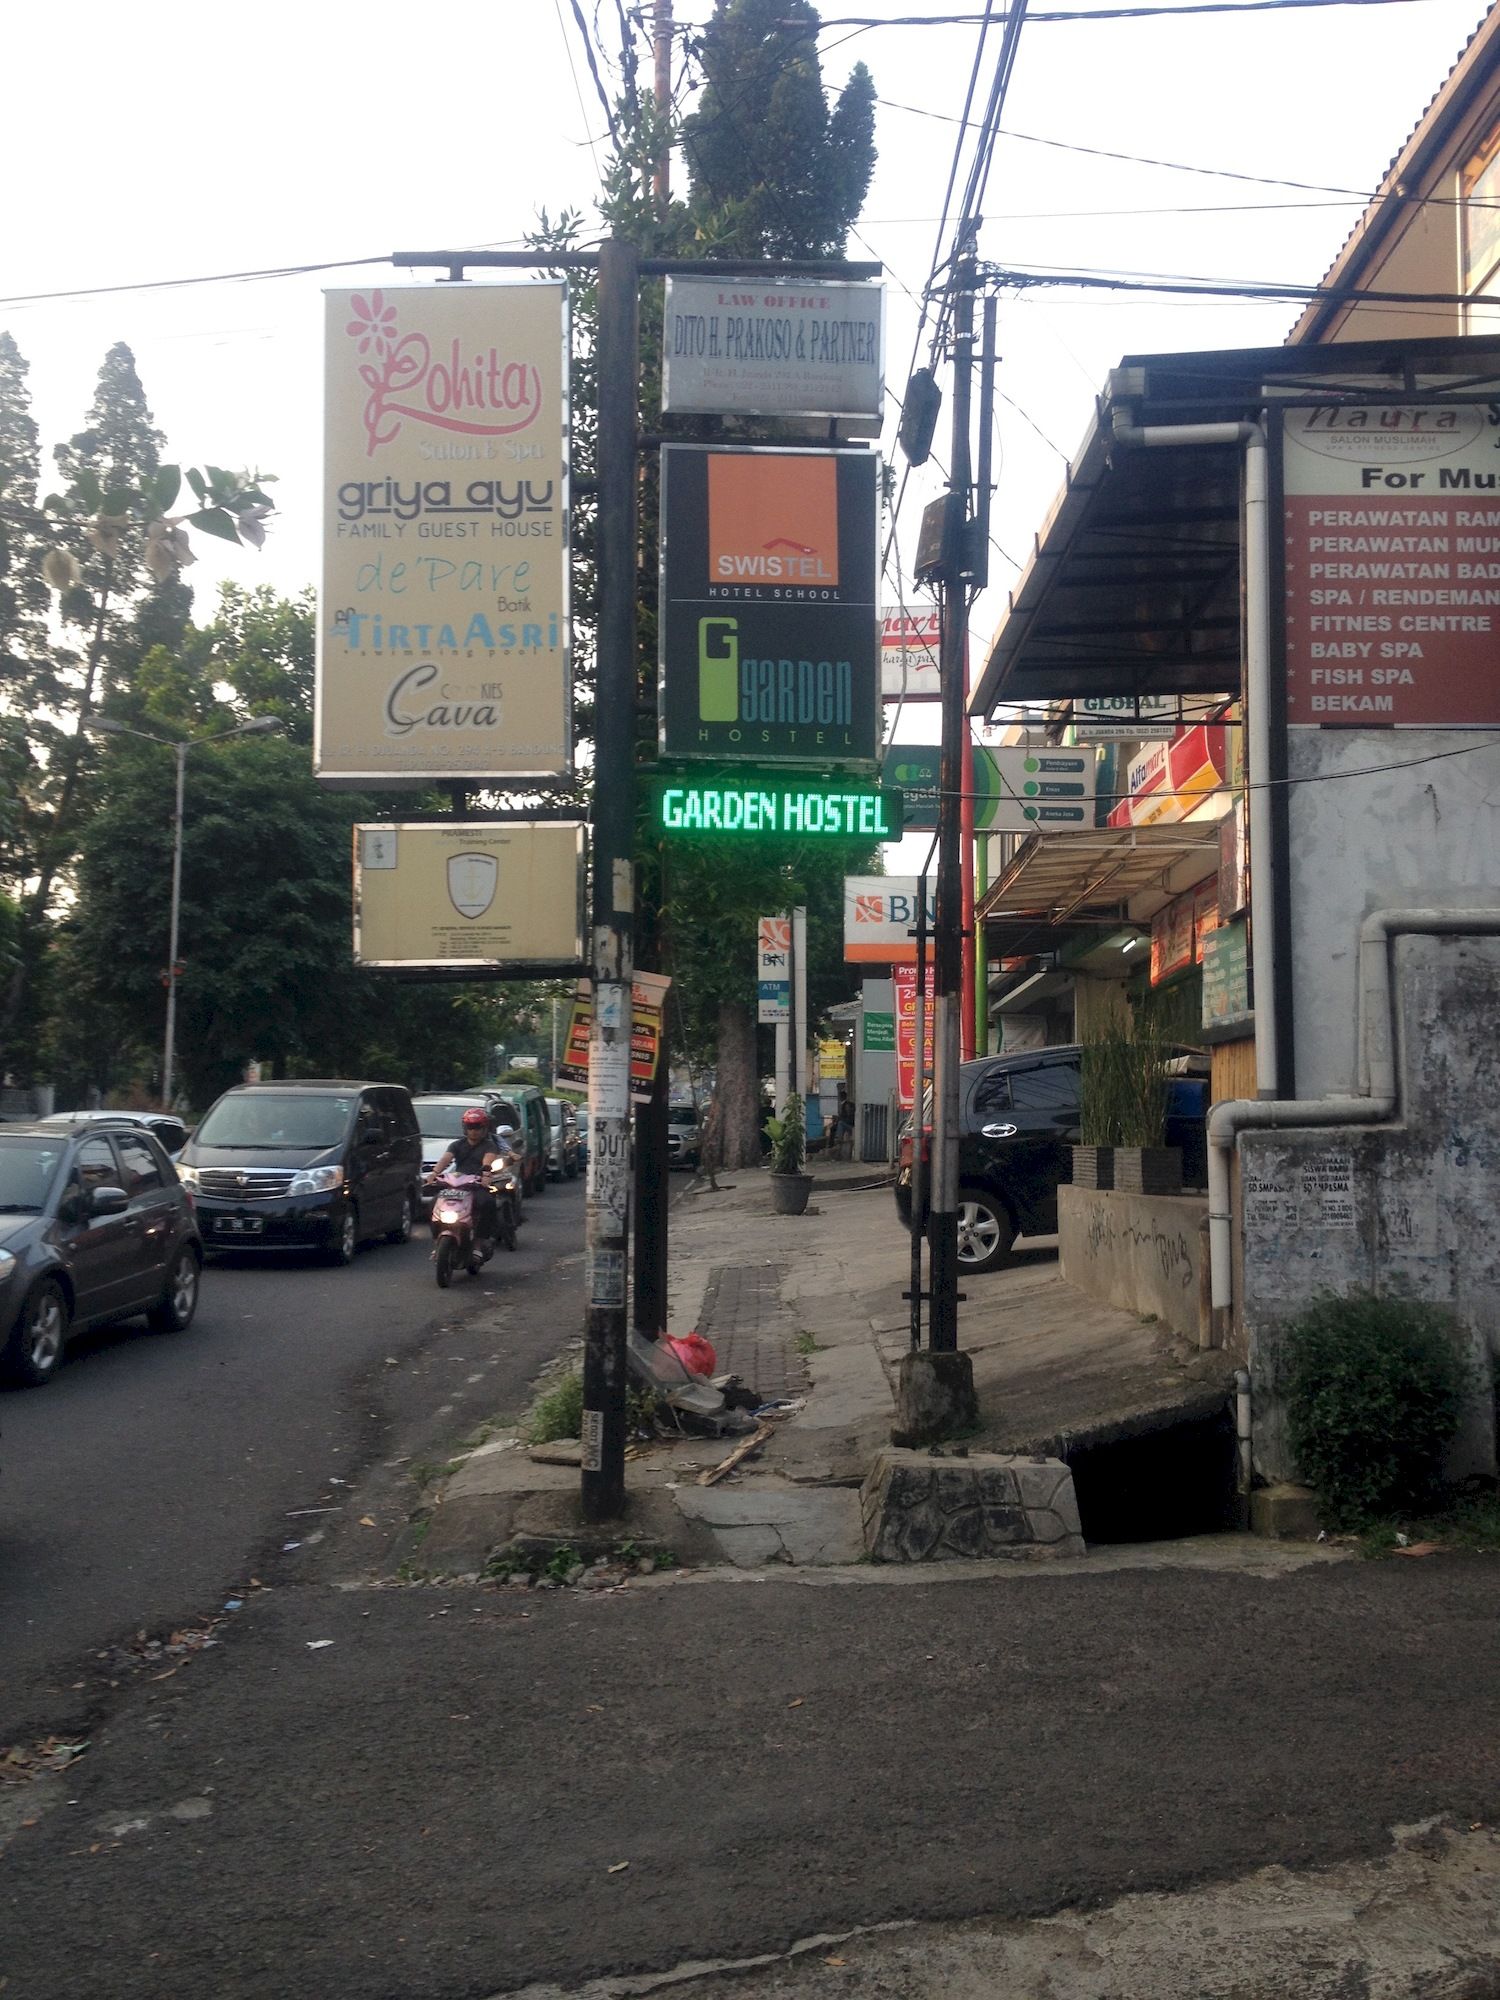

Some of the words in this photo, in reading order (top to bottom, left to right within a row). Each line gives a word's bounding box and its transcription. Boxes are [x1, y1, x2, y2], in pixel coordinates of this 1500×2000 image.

[718, 294, 755, 306] LAW
[763, 295, 830, 309] OFFICE
[675, 315, 705, 356] DITO
[727, 317, 792, 362] PRAKOSO
[811, 321, 876, 365] PARTNER
[1330, 436, 1370, 444] SALON
[1374, 436, 1437, 444] MUSLIMAH
[1361, 468, 1425, 489] For
[1439, 468, 1500, 489] Mu
[337, 476, 451, 520] griya
[466, 480, 553, 520] ayu
[1308, 511, 1448, 527] PERAWATAN
[337, 523, 407, 538] FAMILY
[418, 522, 479, 538] GUEST
[491, 522, 553, 537] HOUSE
[1309, 537, 1449, 553] PERAWATAN
[717, 555, 832, 578] SWISTEL
[1310, 563, 1449, 579] PERAWATAN
[709, 588, 762, 597] HOTEL
[774, 589, 840, 599] SCHOOL
[1309, 589, 1353, 605] SPA
[1359, 589, 1365, 605] /
[1372, 589, 1500, 605] RENDEMAN
[498, 597, 532, 613] Batik
[1310, 616, 1392, 632] FITNES
[1400, 616, 1491, 632] CENTRE
[1310, 642, 1373, 658] BABY
[1380, 642, 1423, 658] SPA
[1311, 669, 1363, 684] FISH
[1370, 669, 1414, 684] SPA
[441, 683, 503, 699] CKIES
[386, 664, 497, 735] Cava
[1311, 696, 1393, 711] BEKAM
[699, 729, 851, 745] HOSTEL
[662, 790, 776, 830] GARDEN
[783, 793, 888, 834] HOSTEL
[889, 896, 936, 922] BN
[763, 953, 785, 966] BN
[899, 967, 928, 975] Pro
